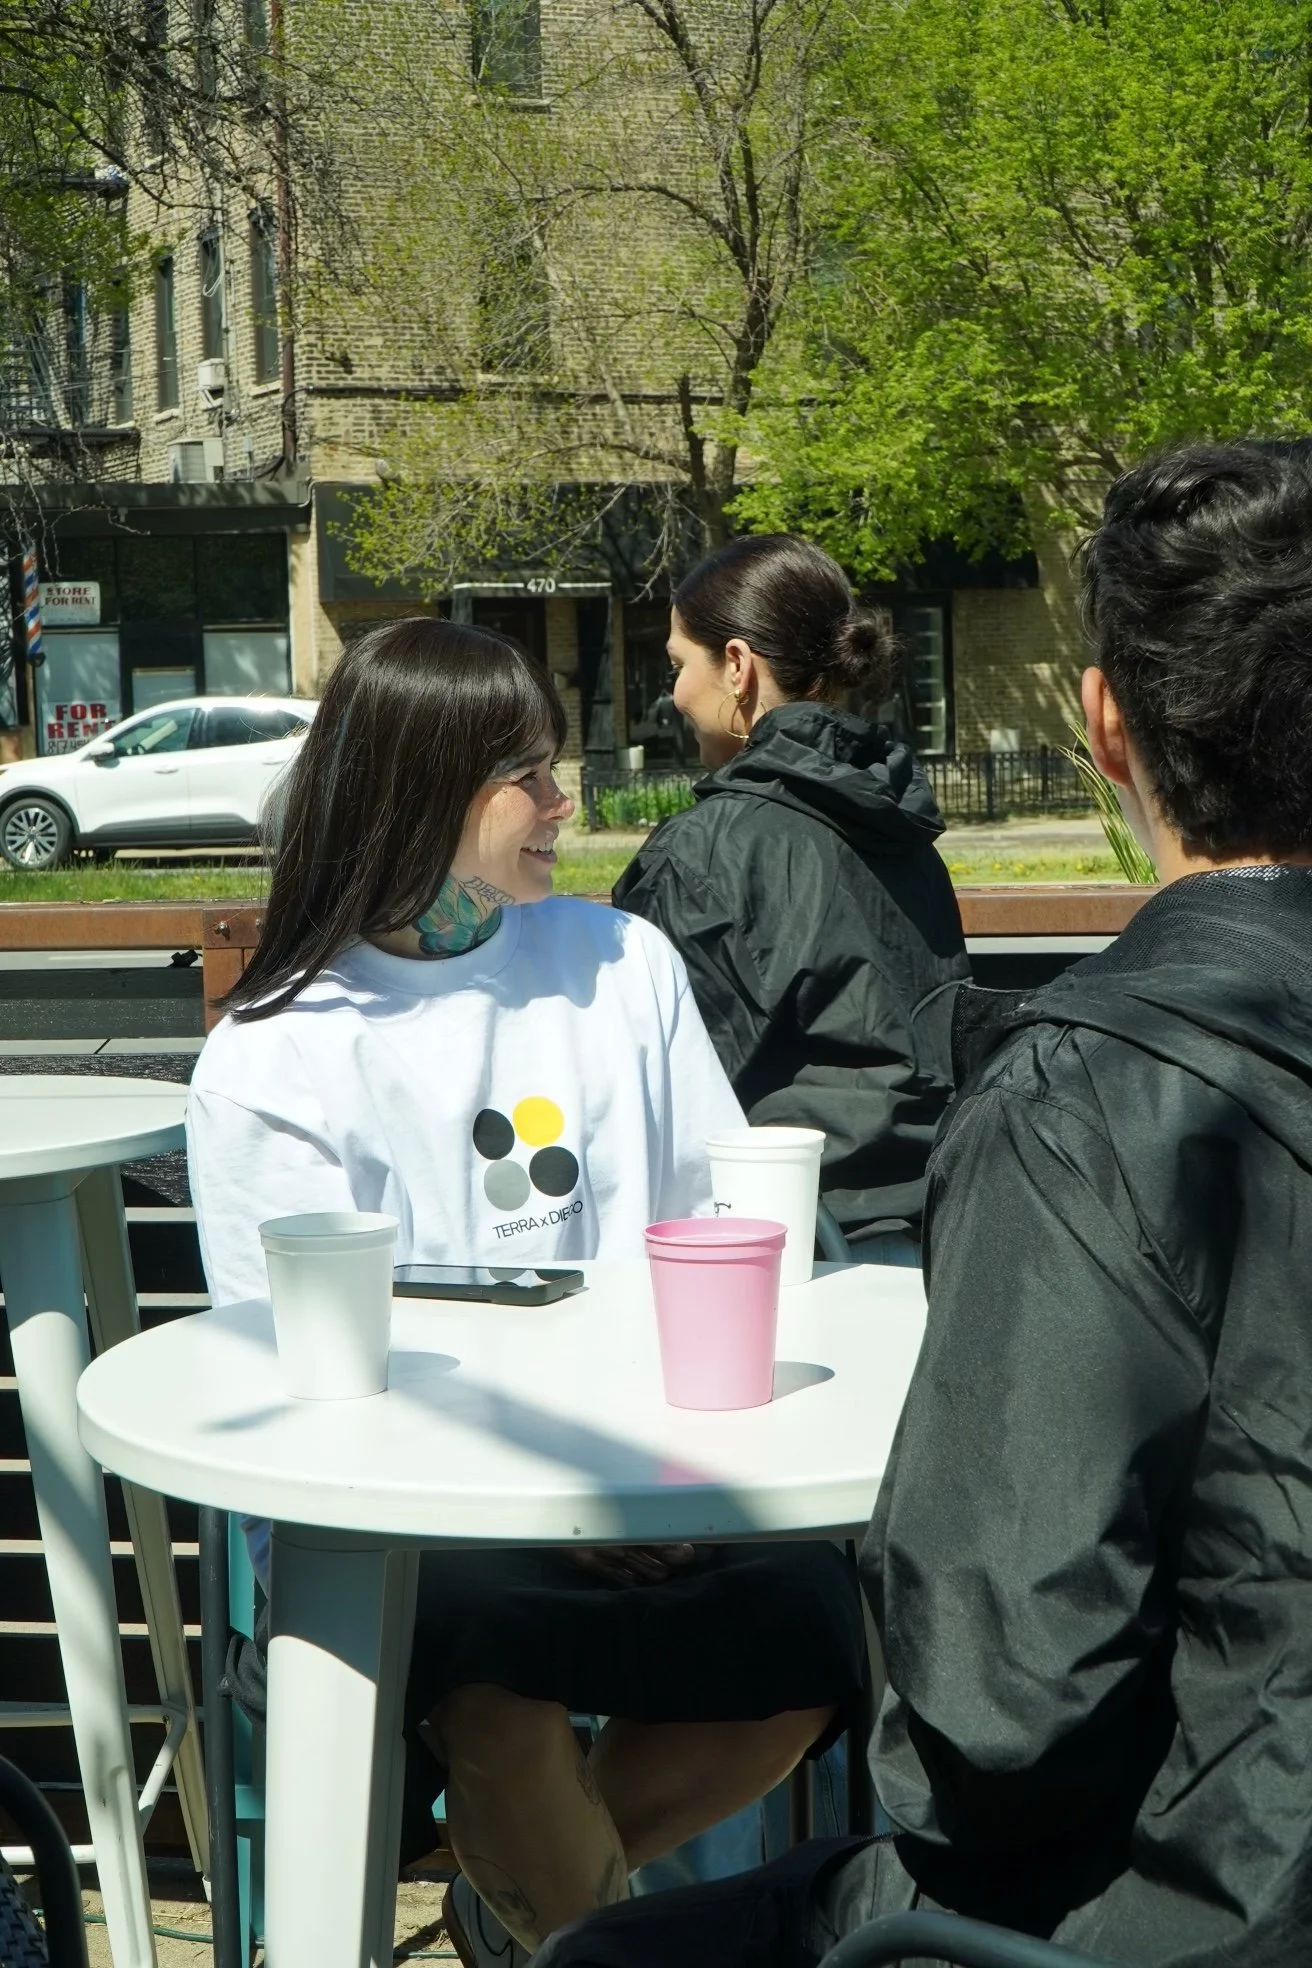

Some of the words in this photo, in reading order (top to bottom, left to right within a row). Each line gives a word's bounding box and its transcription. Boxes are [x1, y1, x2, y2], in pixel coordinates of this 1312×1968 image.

[47, 587, 91, 596] STORE
[526, 578, 556, 593] 470
[45, 597, 69, 605] FOR
[71, 596, 96, 605] RENT
[56, 704, 107, 720] FOR
[47, 721, 116, 738] RENT
[492, 1217, 540, 1239] TERRA
